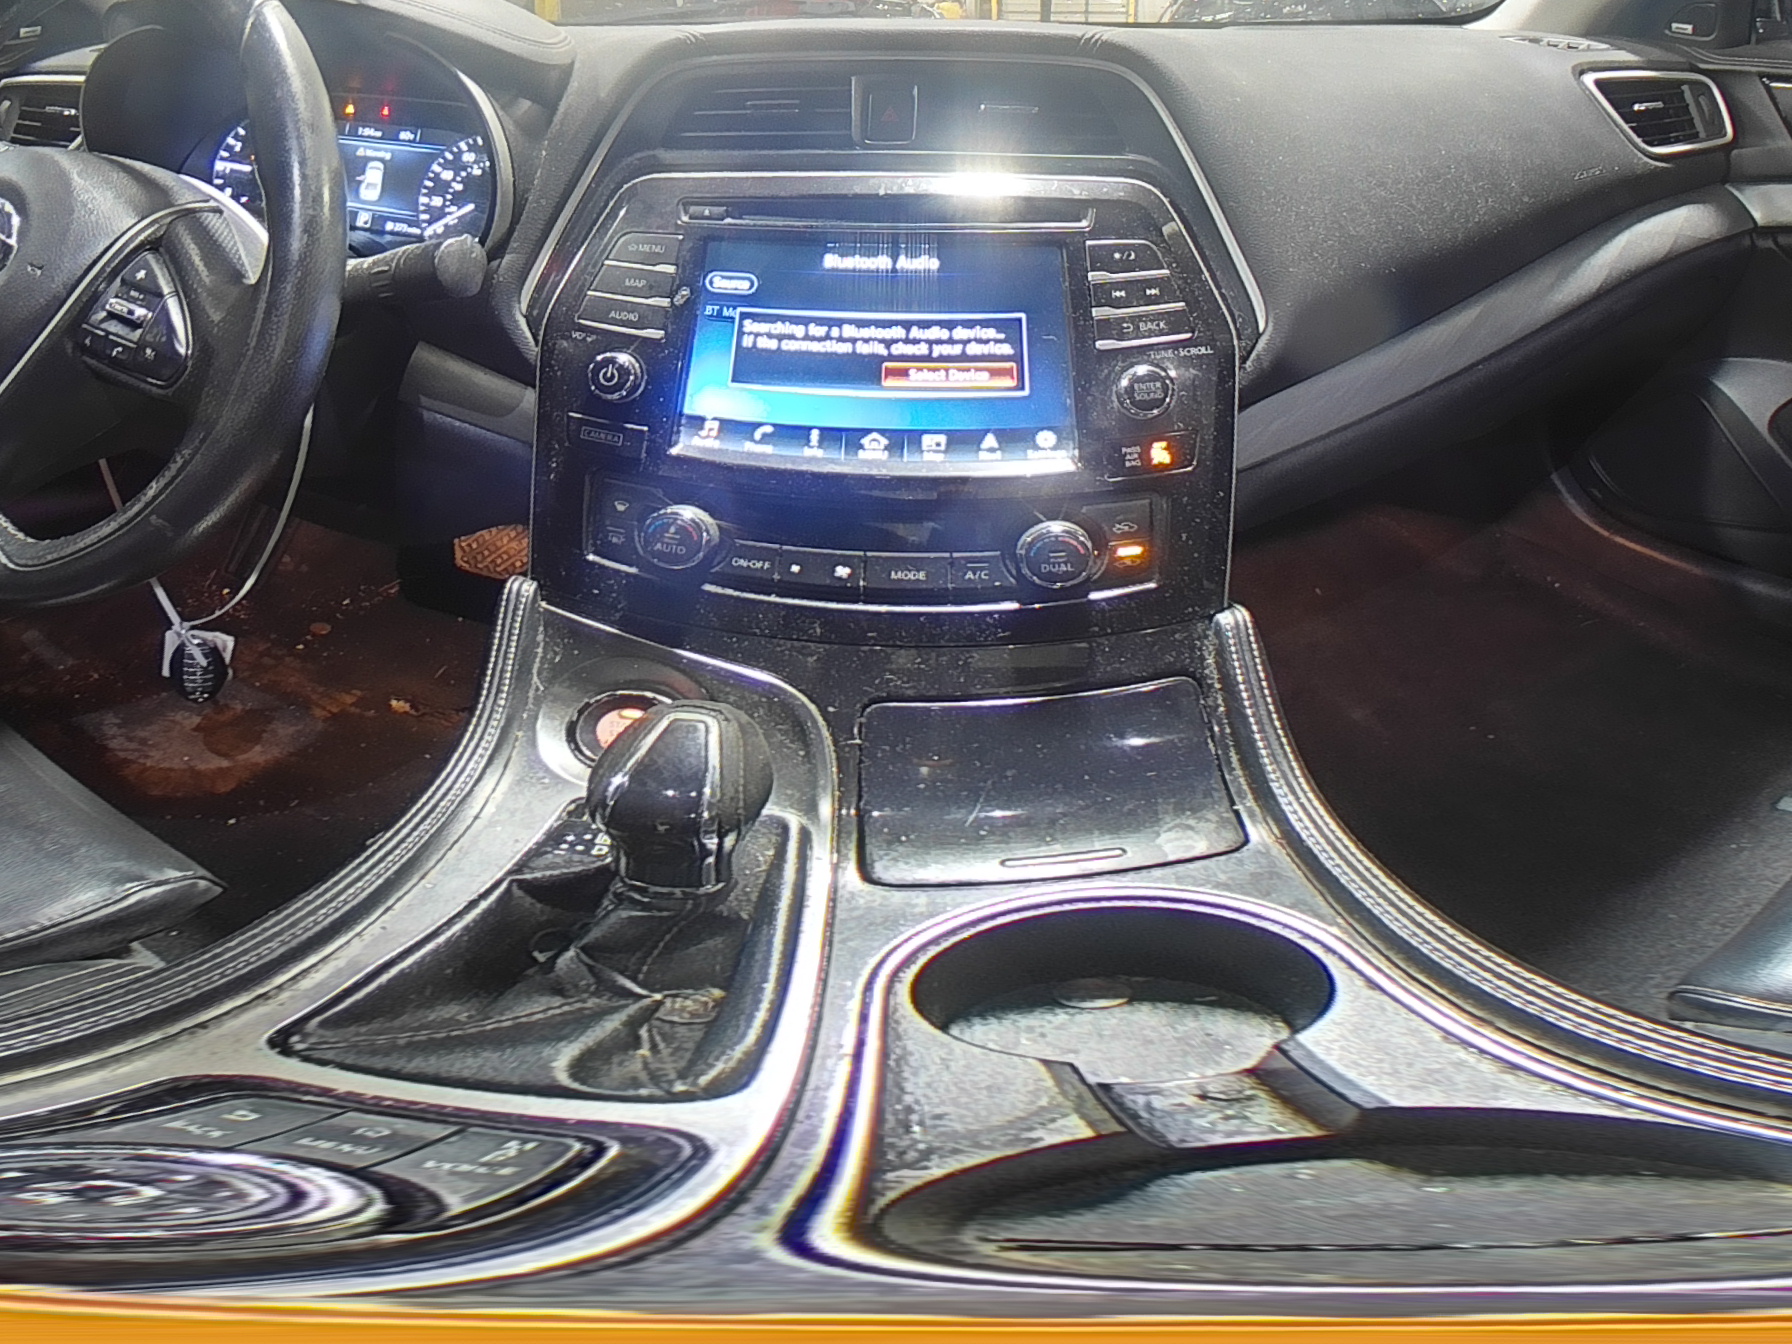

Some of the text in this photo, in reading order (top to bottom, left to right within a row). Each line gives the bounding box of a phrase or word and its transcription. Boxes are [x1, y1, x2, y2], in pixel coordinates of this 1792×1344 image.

[639, 244, 665, 254] MENU
[823, 253, 939, 271] Bluetooth Audio
[625, 277, 647, 287] MAP
[609, 309, 638, 321] AUDIO
[704, 305, 720, 317] BT
[742, 319, 805, 338] Searching
[808, 322, 828, 337] for
[830, 324, 840, 337] a
[842, 322, 906, 339] Bluetooth
[909, 324, 949, 340] Audio
[1139, 320, 1166, 331] BACK
[742, 334, 753, 348] If
[756, 335, 778, 349] the
[781, 336, 853, 354] connection
[890, 340, 929, 355] check
[932, 342, 963, 358] your
[966, 341, 1015, 356] device.
[909, 368, 990, 382] Select Device
[653, 542, 686, 555] AUTO
[1040, 563, 1075, 573] DUAL
[890, 570, 927, 581] MODE
[964, 570, 990, 580] A/C
